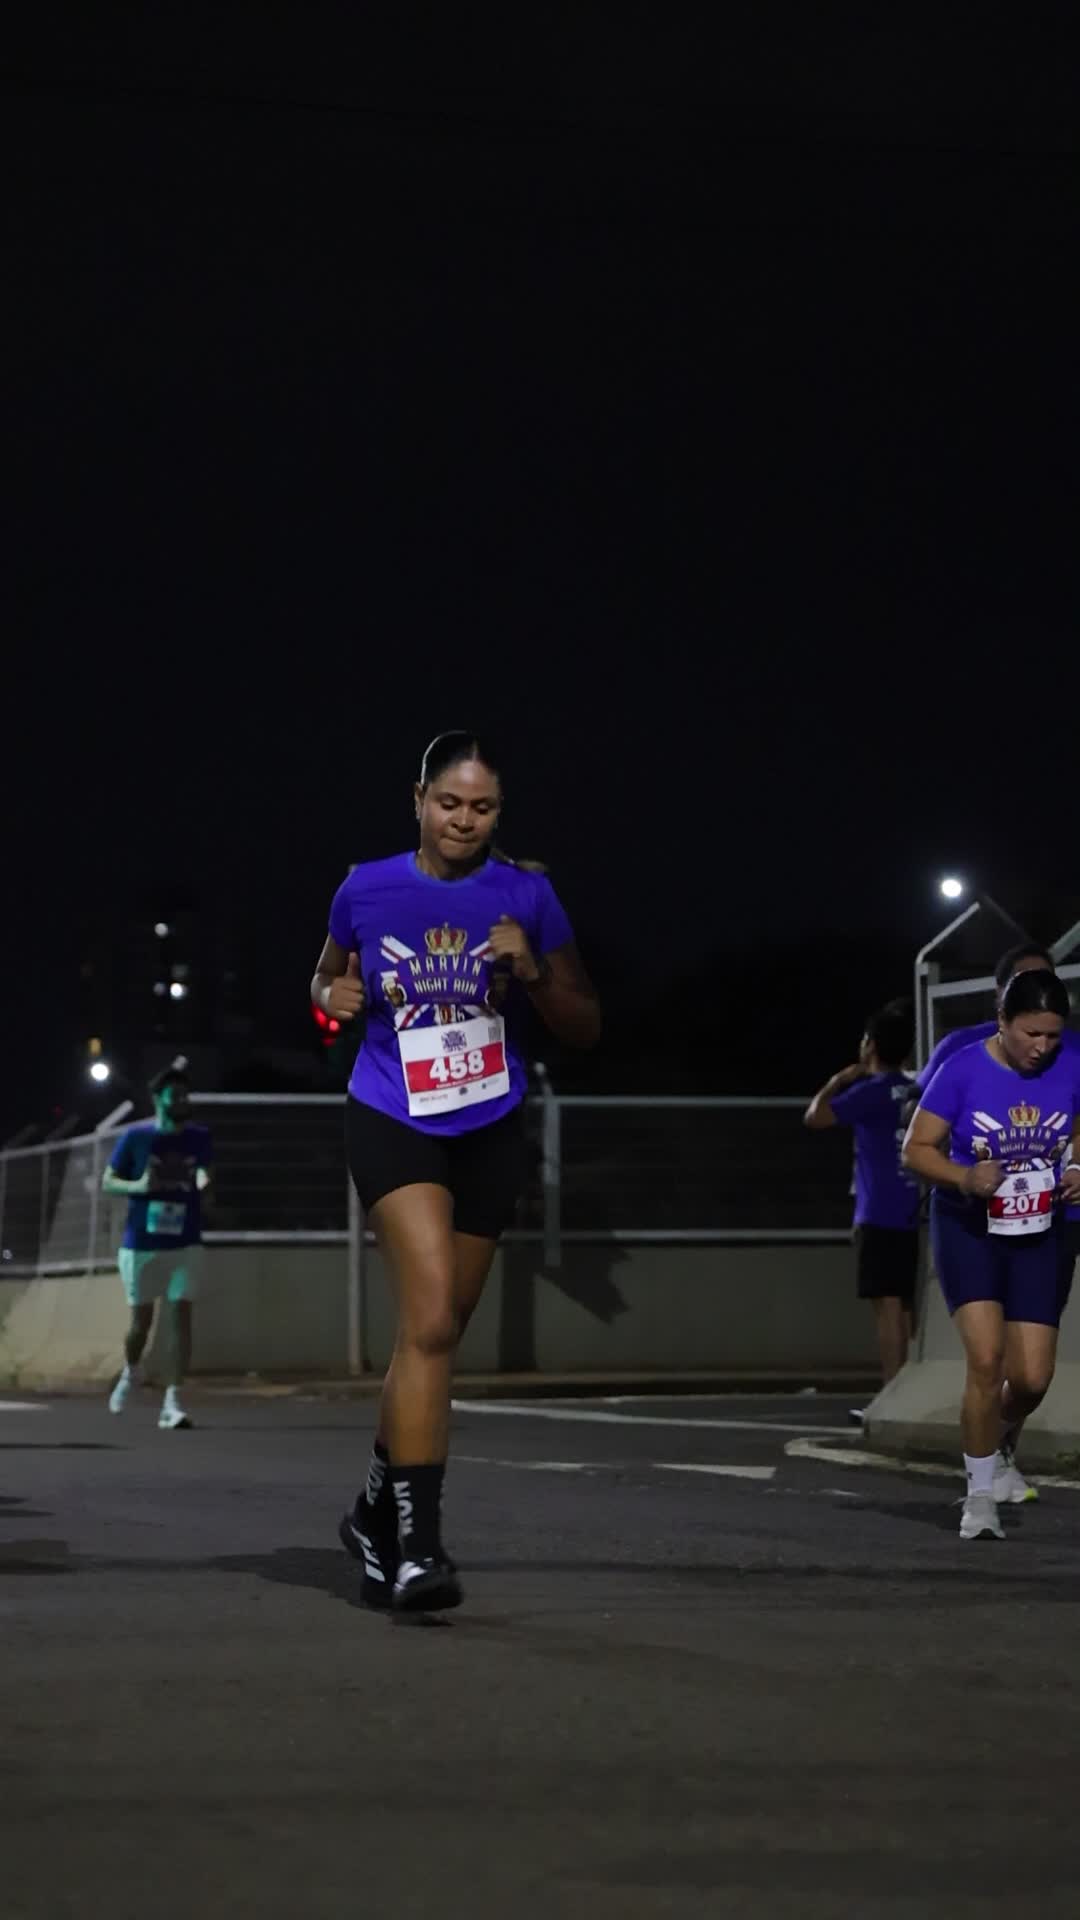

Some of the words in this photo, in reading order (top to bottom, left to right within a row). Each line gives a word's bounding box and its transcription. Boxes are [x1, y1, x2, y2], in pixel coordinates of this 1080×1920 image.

[409, 955, 481, 976] MARVIN
[414, 977, 447, 994] NIGHT
[453, 977, 478, 996] RUN
[429, 1049, 485, 1083] 458
[998, 1127, 1051, 1141] MARVIN
[1002, 1193, 1041, 1215] 207
